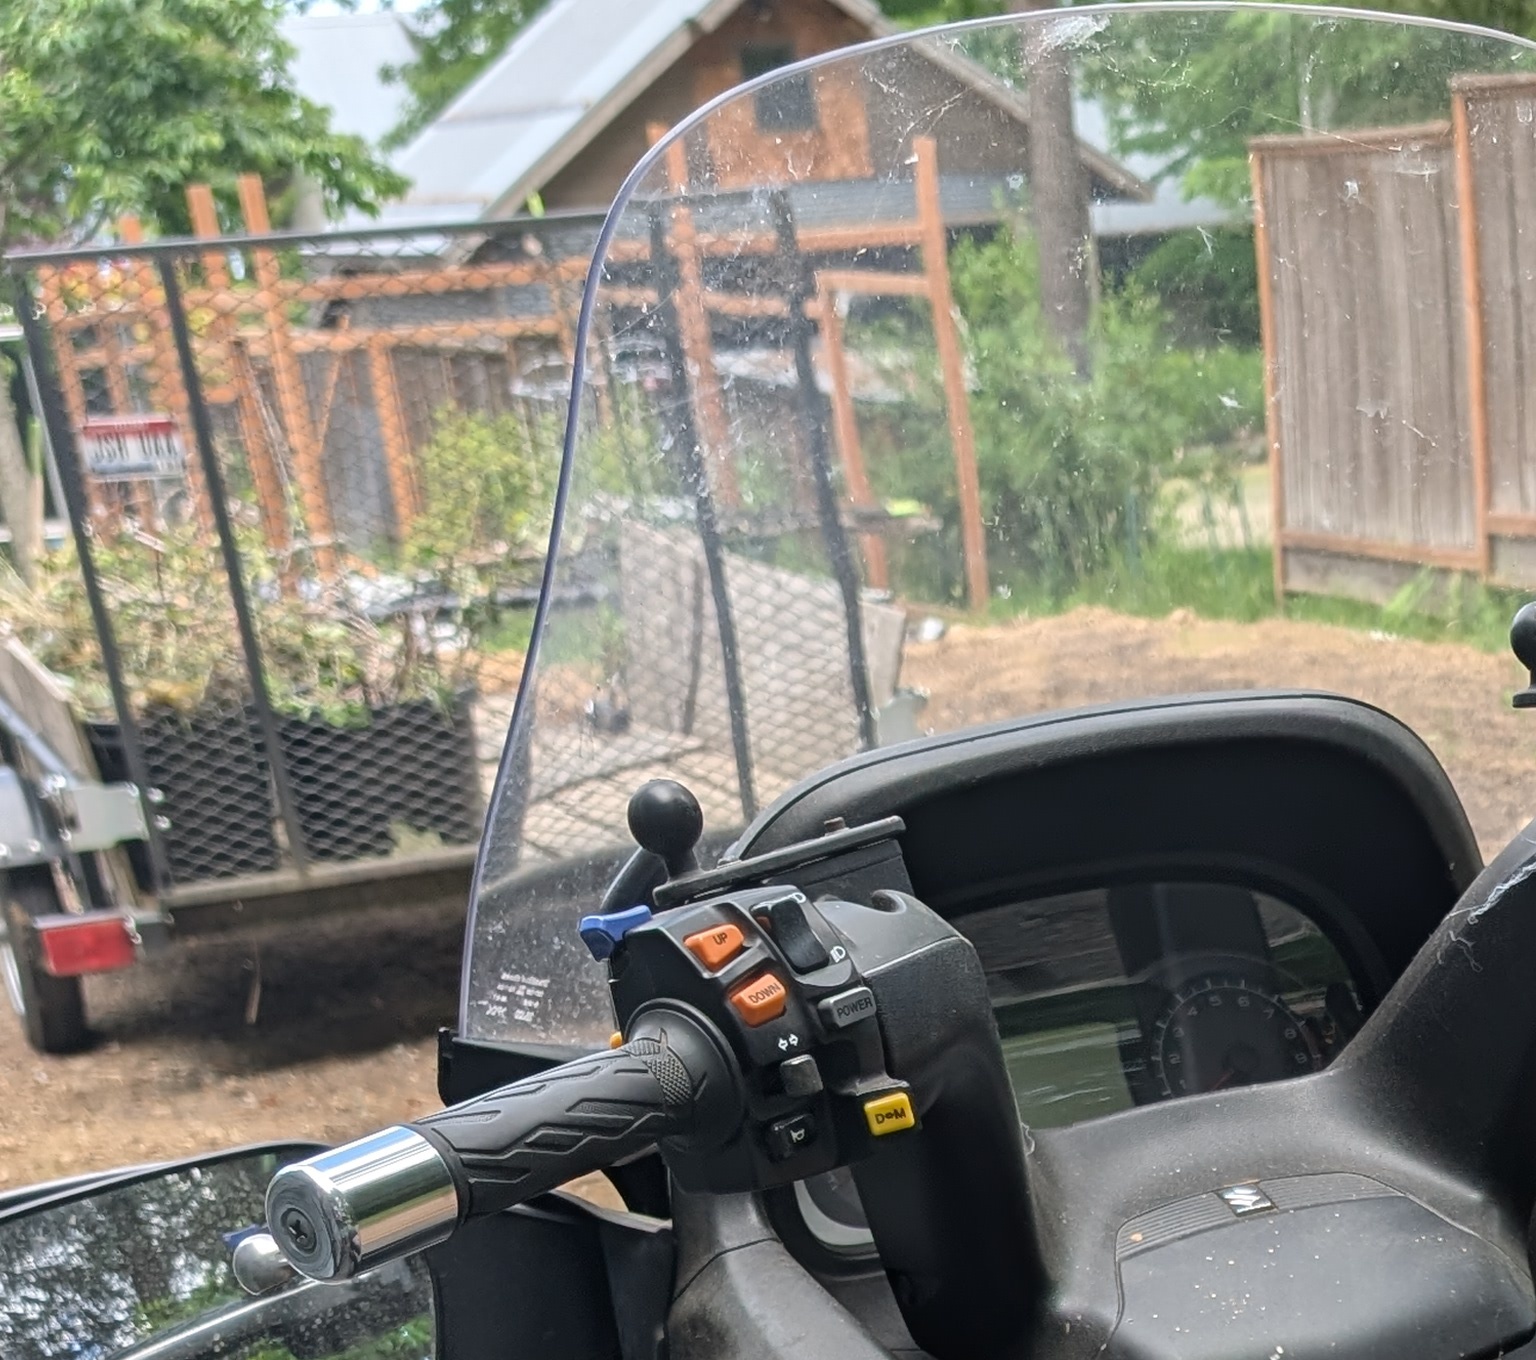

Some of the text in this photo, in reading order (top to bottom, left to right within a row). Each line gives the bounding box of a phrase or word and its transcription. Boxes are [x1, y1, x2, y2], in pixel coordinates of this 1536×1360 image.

[712, 931, 728, 945] UP
[748, 982, 782, 1005] DOWN
[1208, 995, 1222, 1007] 5
[1238, 995, 1250, 1008] 6
[836, 996, 873, 1019] POWER
[1187, 1006, 1198, 1017] 4
[1263, 1008, 1275, 1020] 7
[1169, 1053, 1181, 1064] 2
[1295, 1053, 1308, 1064] 9
